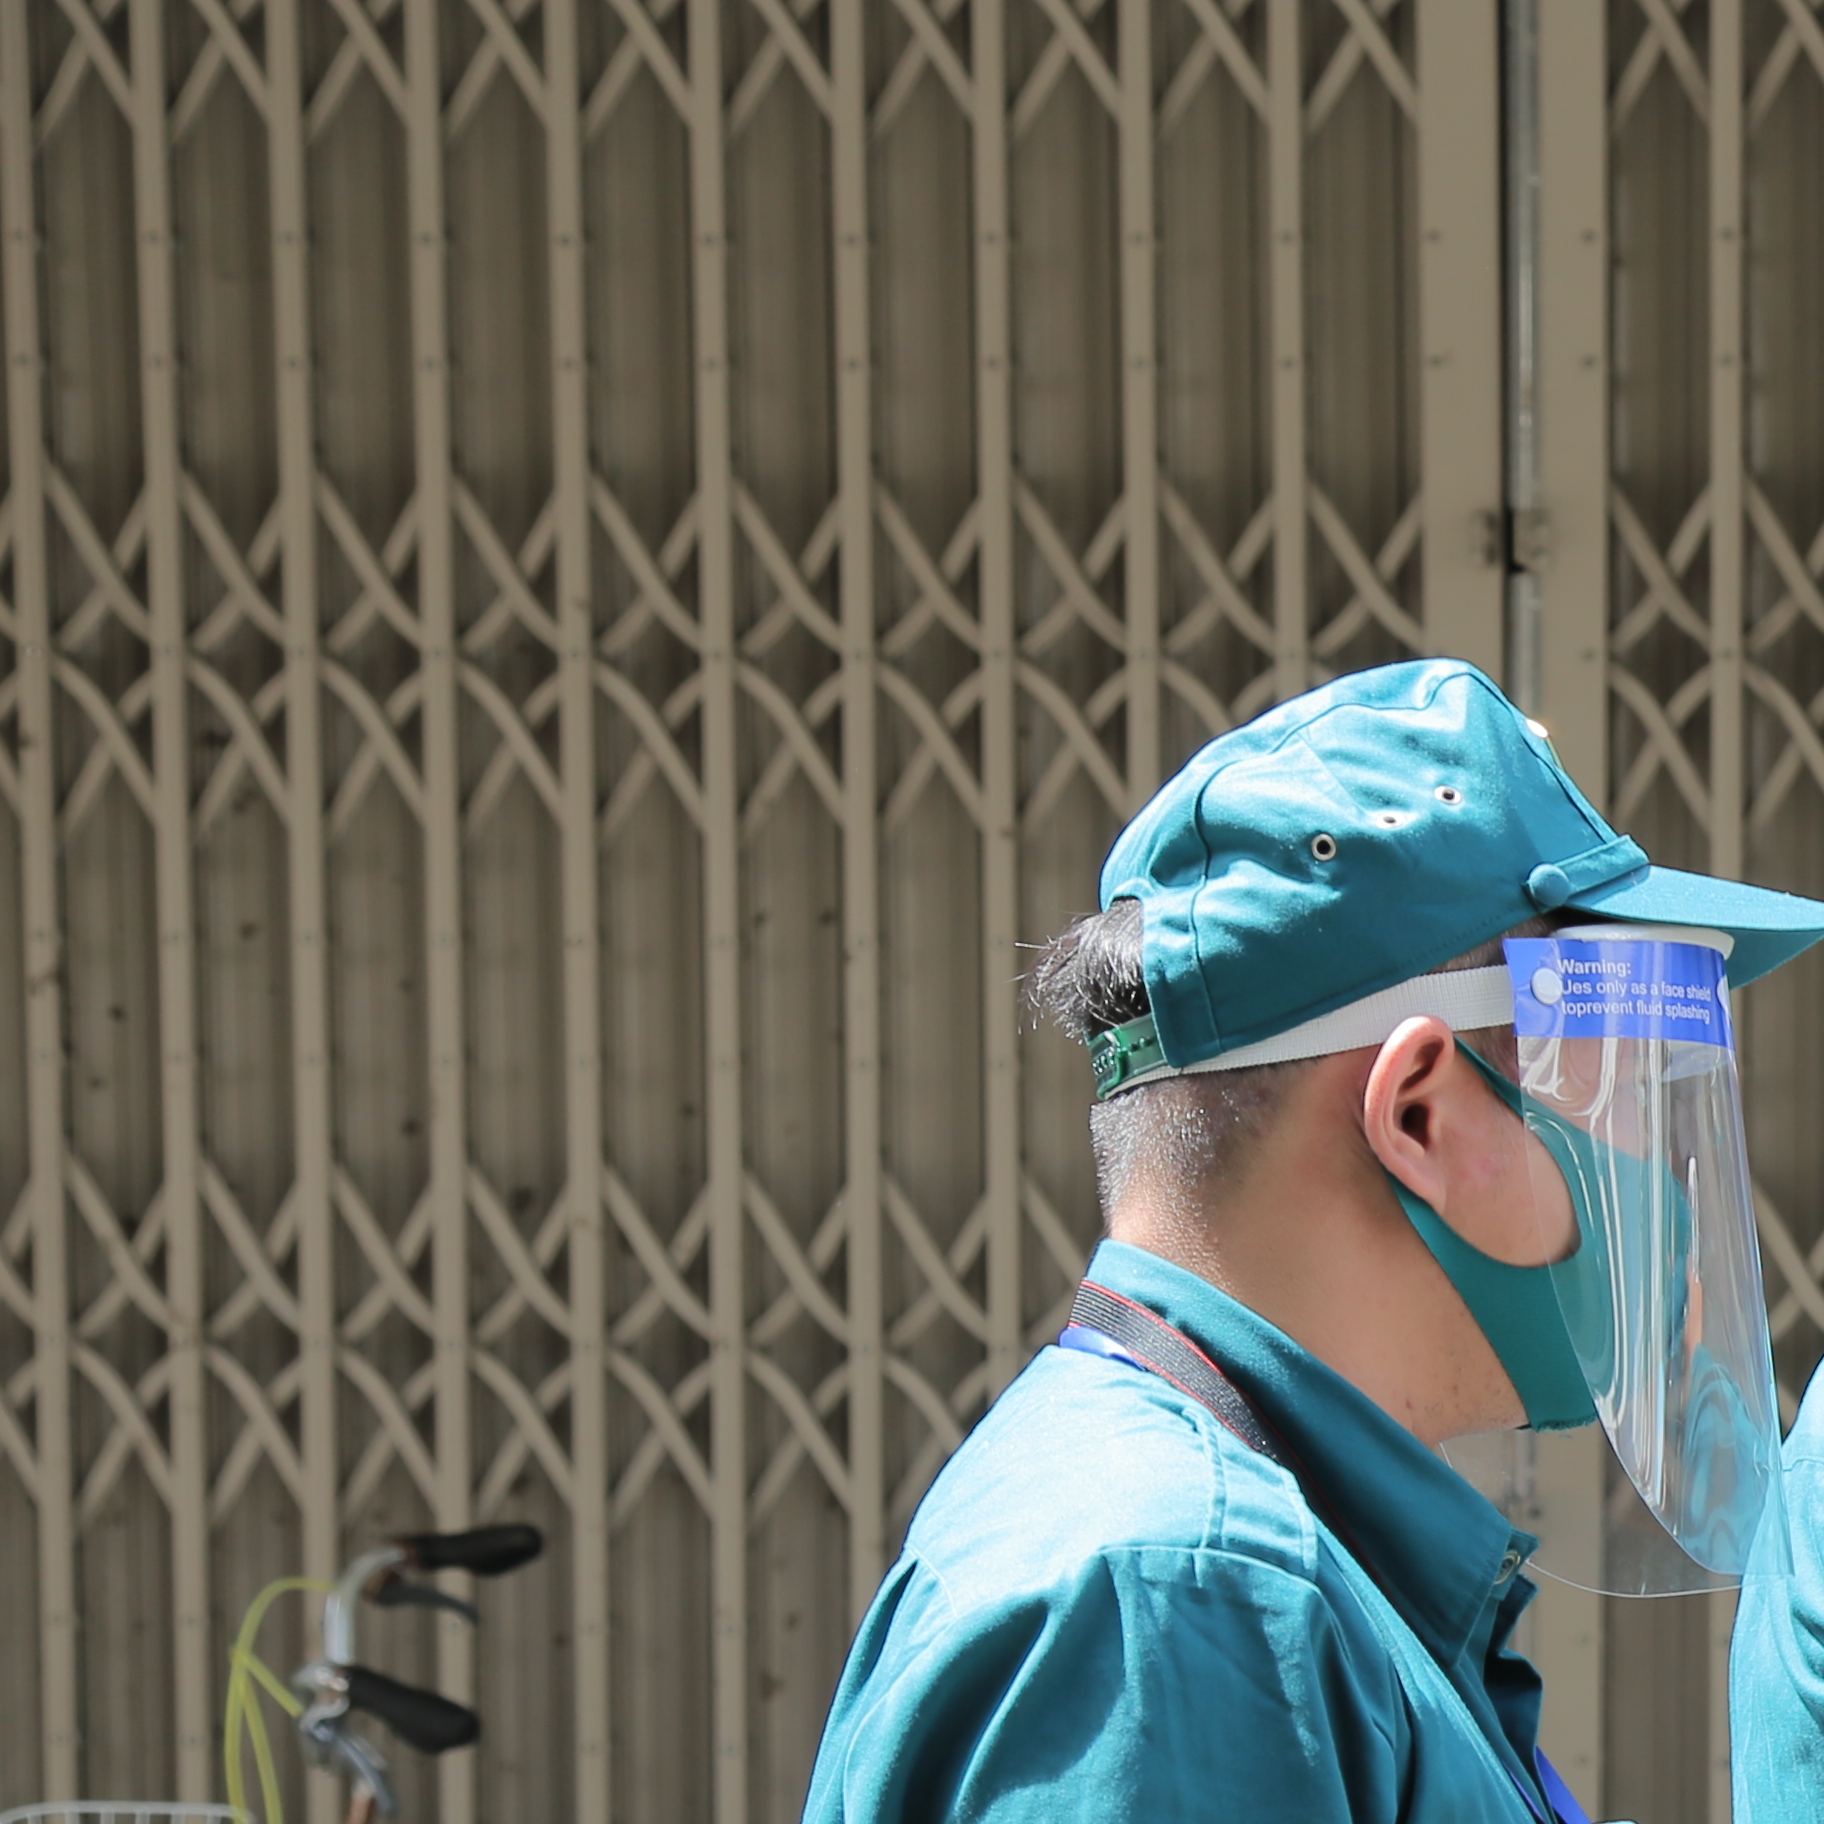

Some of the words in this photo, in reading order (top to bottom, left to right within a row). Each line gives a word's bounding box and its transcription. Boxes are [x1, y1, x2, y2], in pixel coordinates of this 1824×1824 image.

[1557, 959, 1631, 977] Warning:
[1596, 980, 1628, 998] only
[1631, 982, 1647, 995] as
[1650, 983, 1658, 996] a
[1661, 981, 1685, 999] face
[1686, 984, 1712, 1003] shield
[1561, 1001, 1634, 1018] toprevent
[1636, 1001, 1663, 1016] fluid
[1665, 1003, 1711, 1025] splashing
